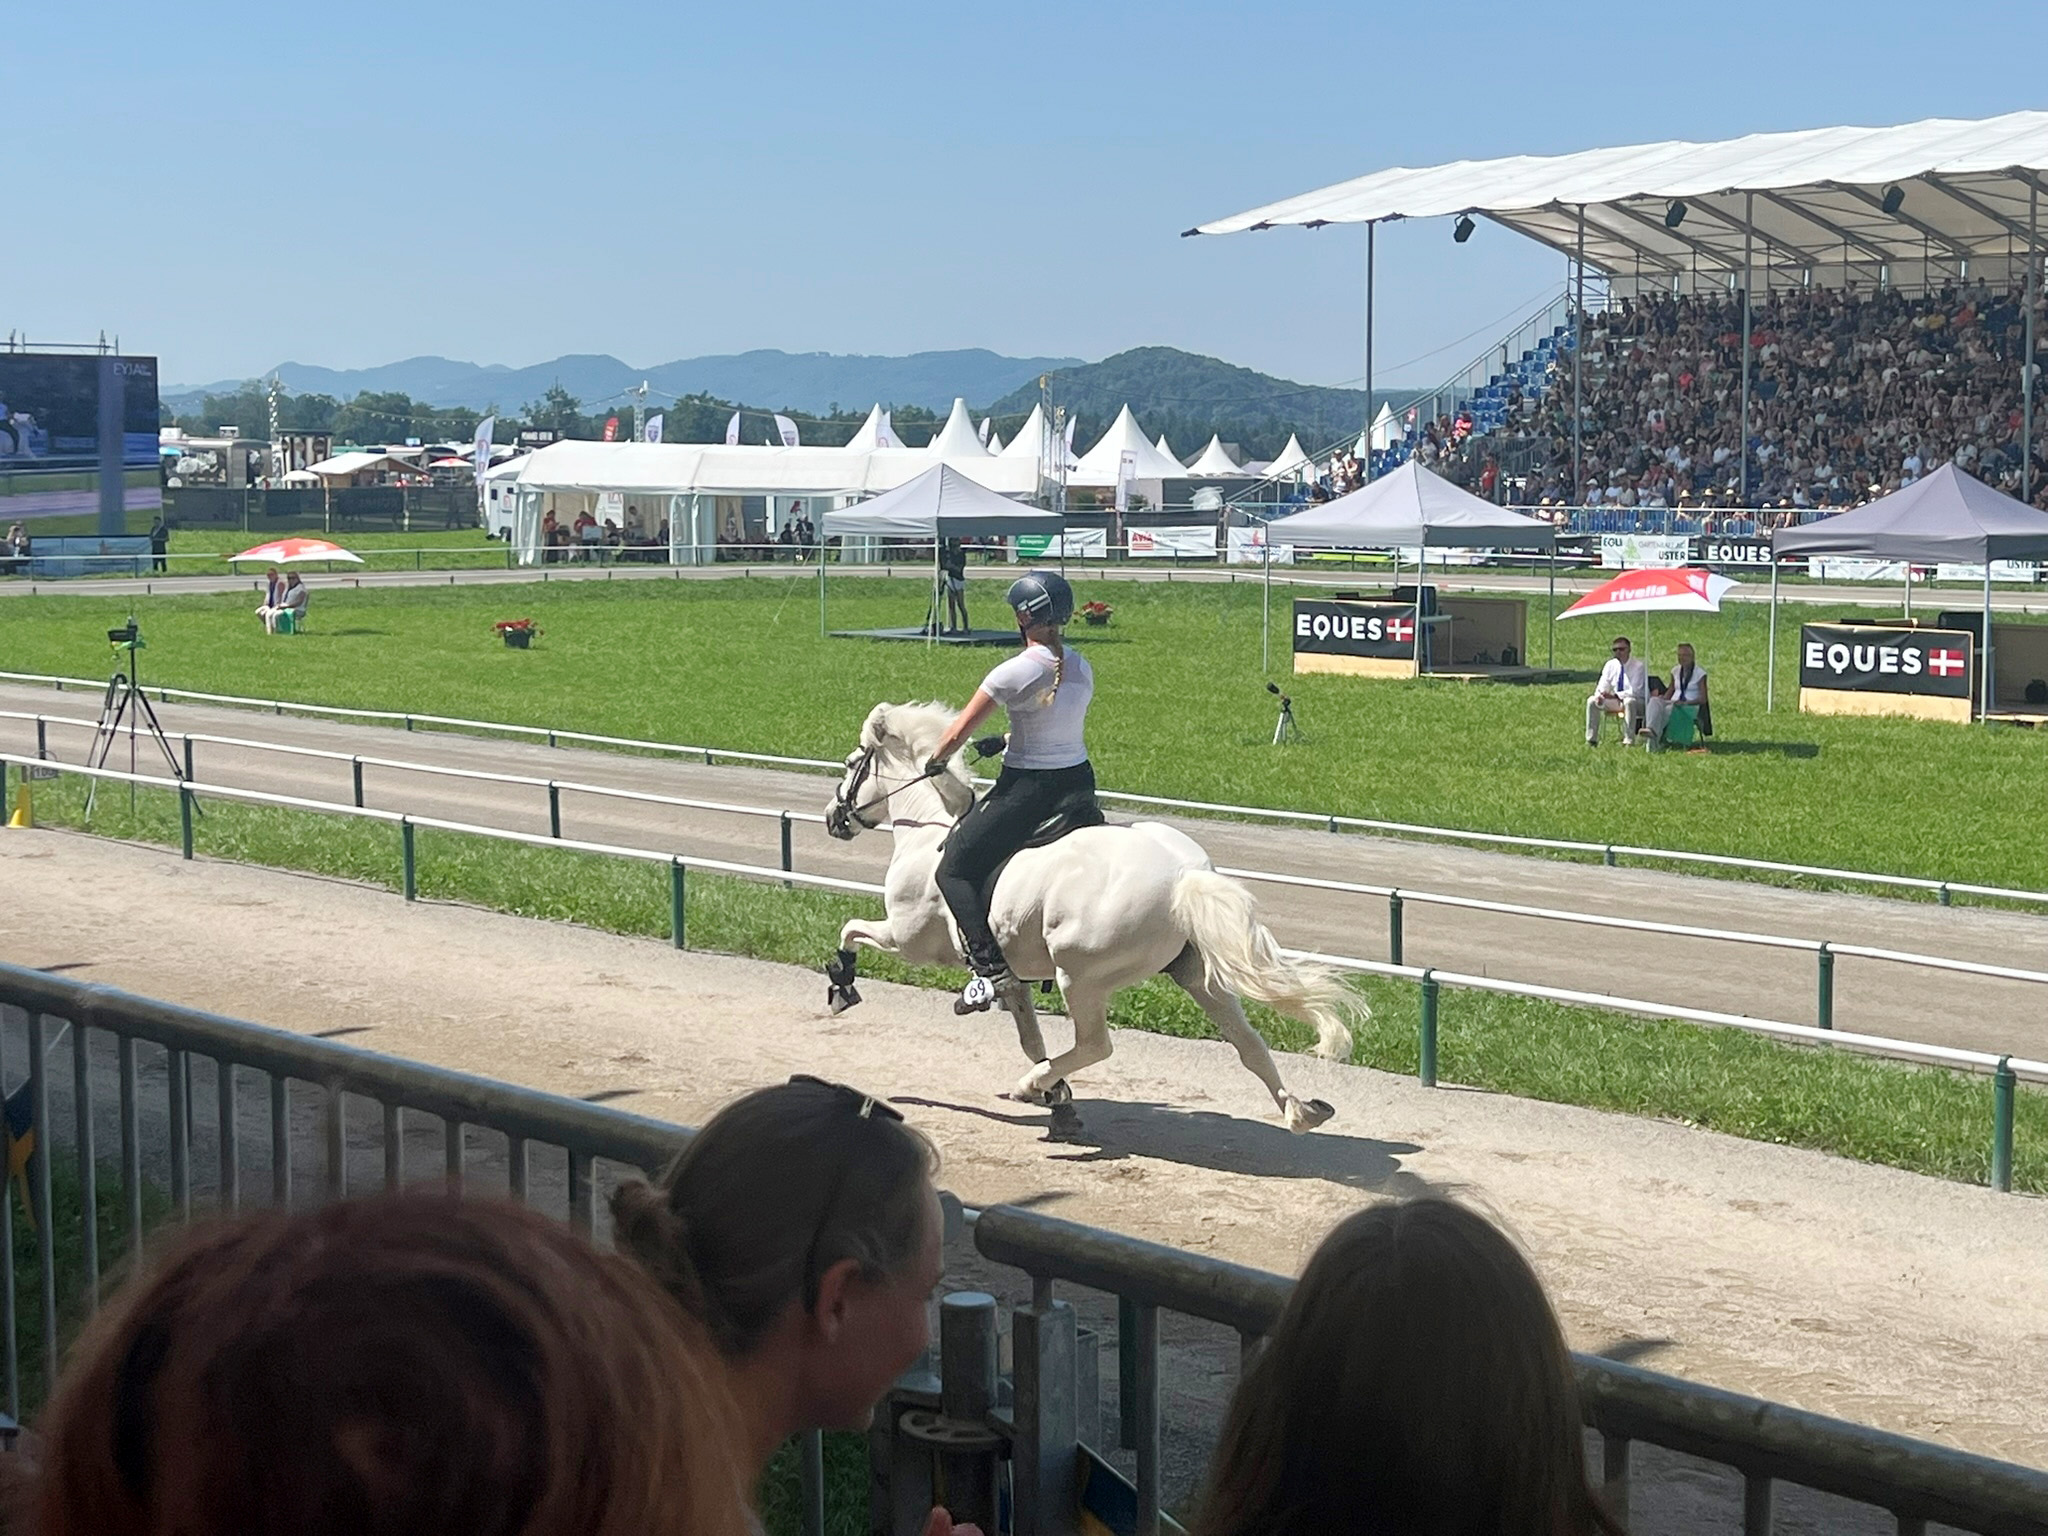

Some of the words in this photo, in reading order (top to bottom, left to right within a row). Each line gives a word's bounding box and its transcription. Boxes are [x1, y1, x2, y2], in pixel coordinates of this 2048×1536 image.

[1658, 550, 1687, 561] USTER
[1707, 545, 1772, 562] EQUES
[1610, 585, 1668, 601] rivella
[1297, 613, 1382, 640] EQUES
[1805, 642, 1922, 674] EQUES
